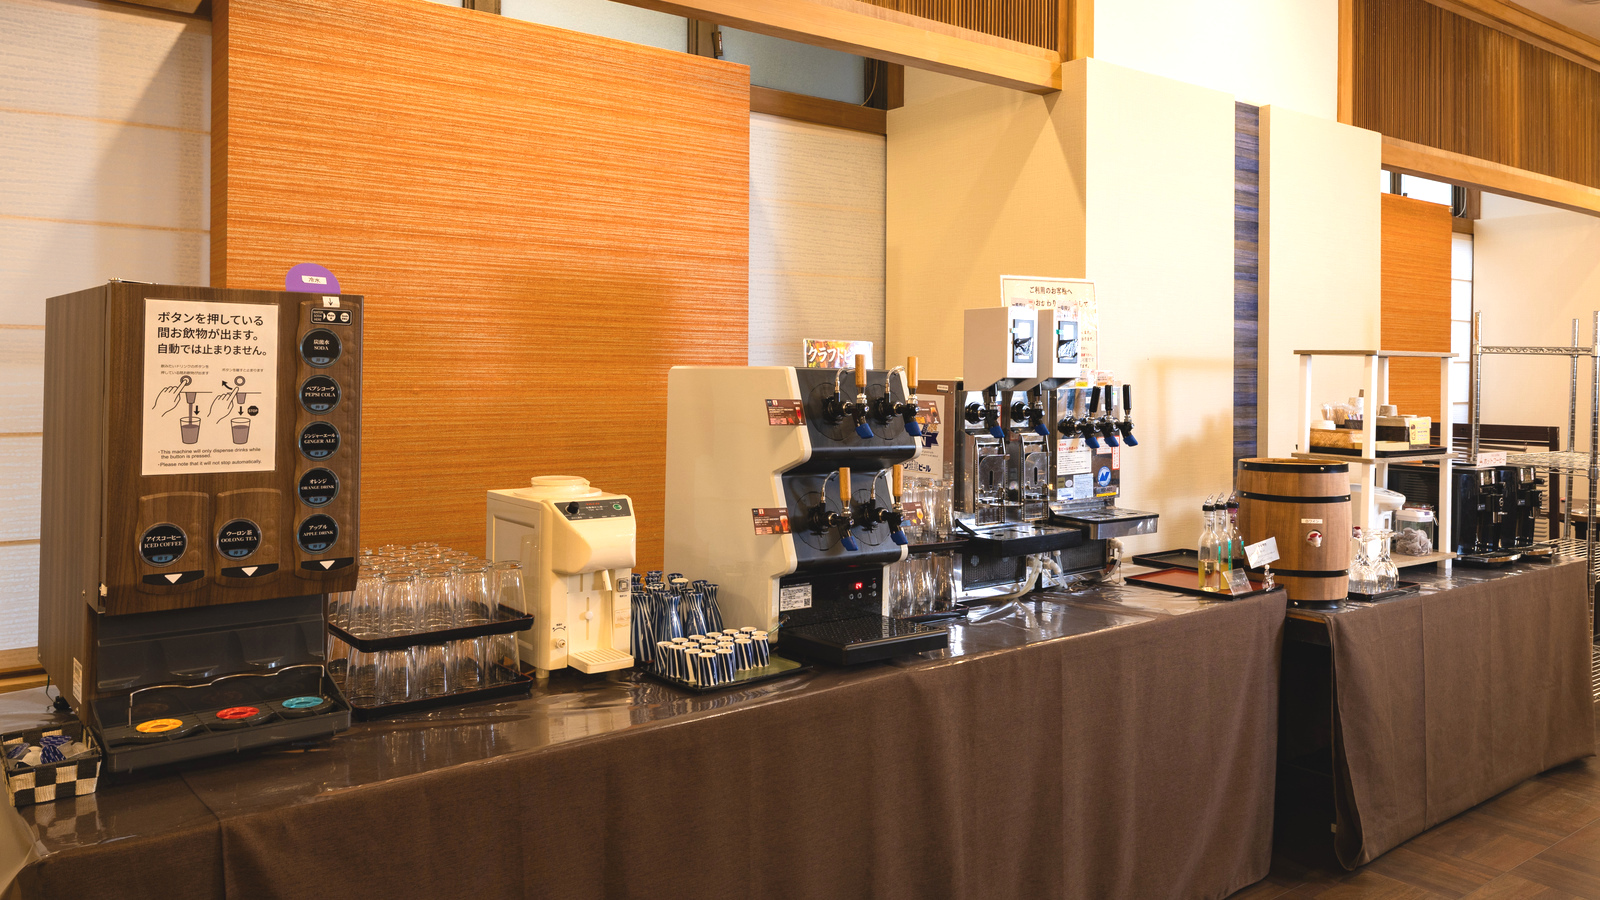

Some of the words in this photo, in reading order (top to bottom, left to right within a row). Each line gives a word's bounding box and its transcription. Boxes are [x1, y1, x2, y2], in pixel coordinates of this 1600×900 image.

[158, 312, 264, 326] ボタンを押している
[158, 327, 258, 341] 間お飲物が出ます。
[158, 343, 266, 356] 自動では止まりません。
